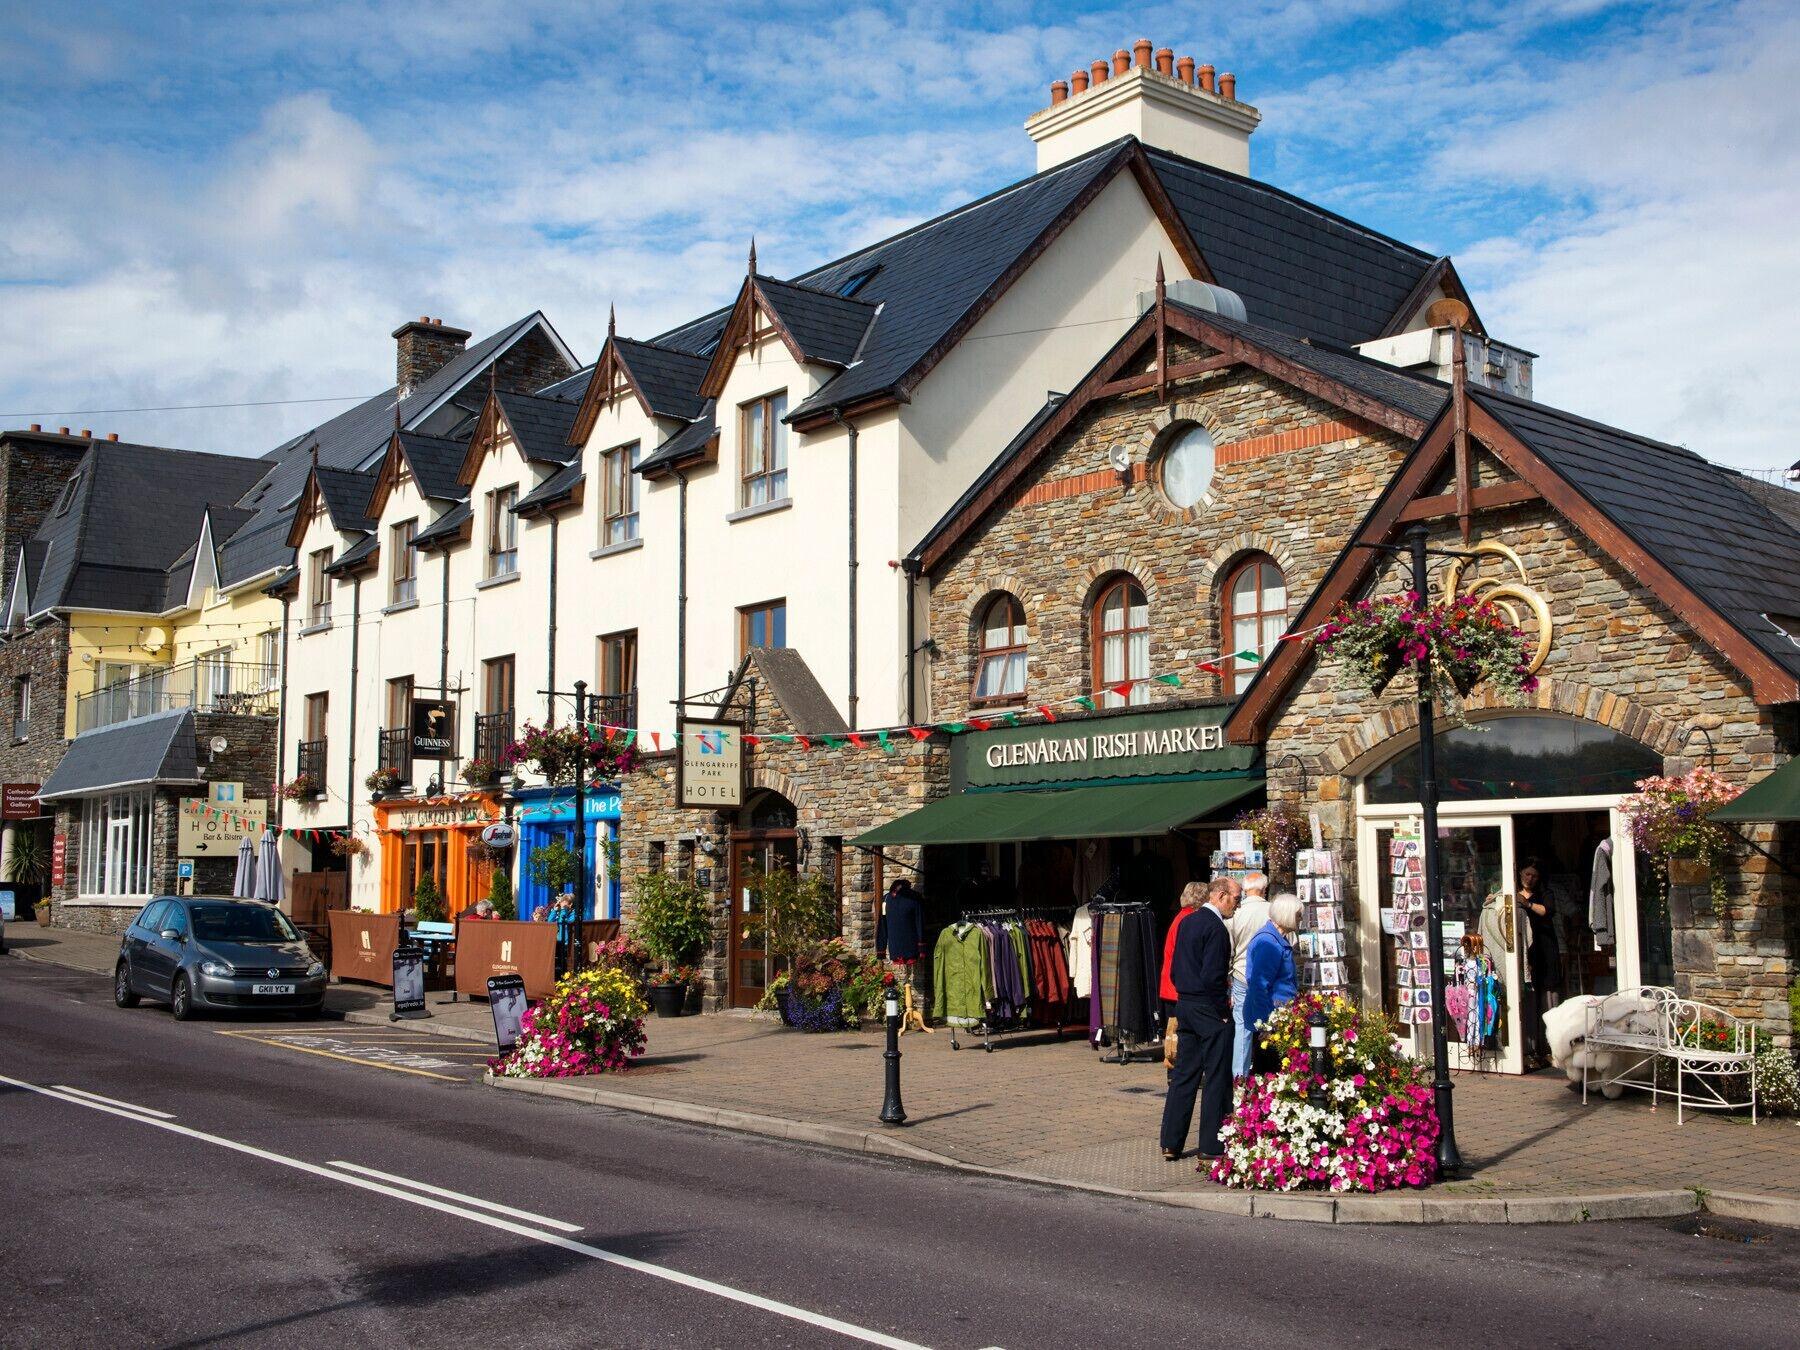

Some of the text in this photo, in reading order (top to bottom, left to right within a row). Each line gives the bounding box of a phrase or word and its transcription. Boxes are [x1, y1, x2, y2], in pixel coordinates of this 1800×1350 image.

[414, 736, 451, 748] GUINNESS
[986, 725, 1224, 768] GLENARAN IRISH MARKET
[684, 760, 738, 768] GLENGARRIFF
[701, 769, 722, 777] PARK
[685, 786, 736, 798] HOTEL
[584, 798, 607, 813] The
[191, 821, 255, 832] HOTEL
[224, 833, 243, 841] Bistro
[181, 865, 190, 874] P
[274, 985, 290, 993] YCW
